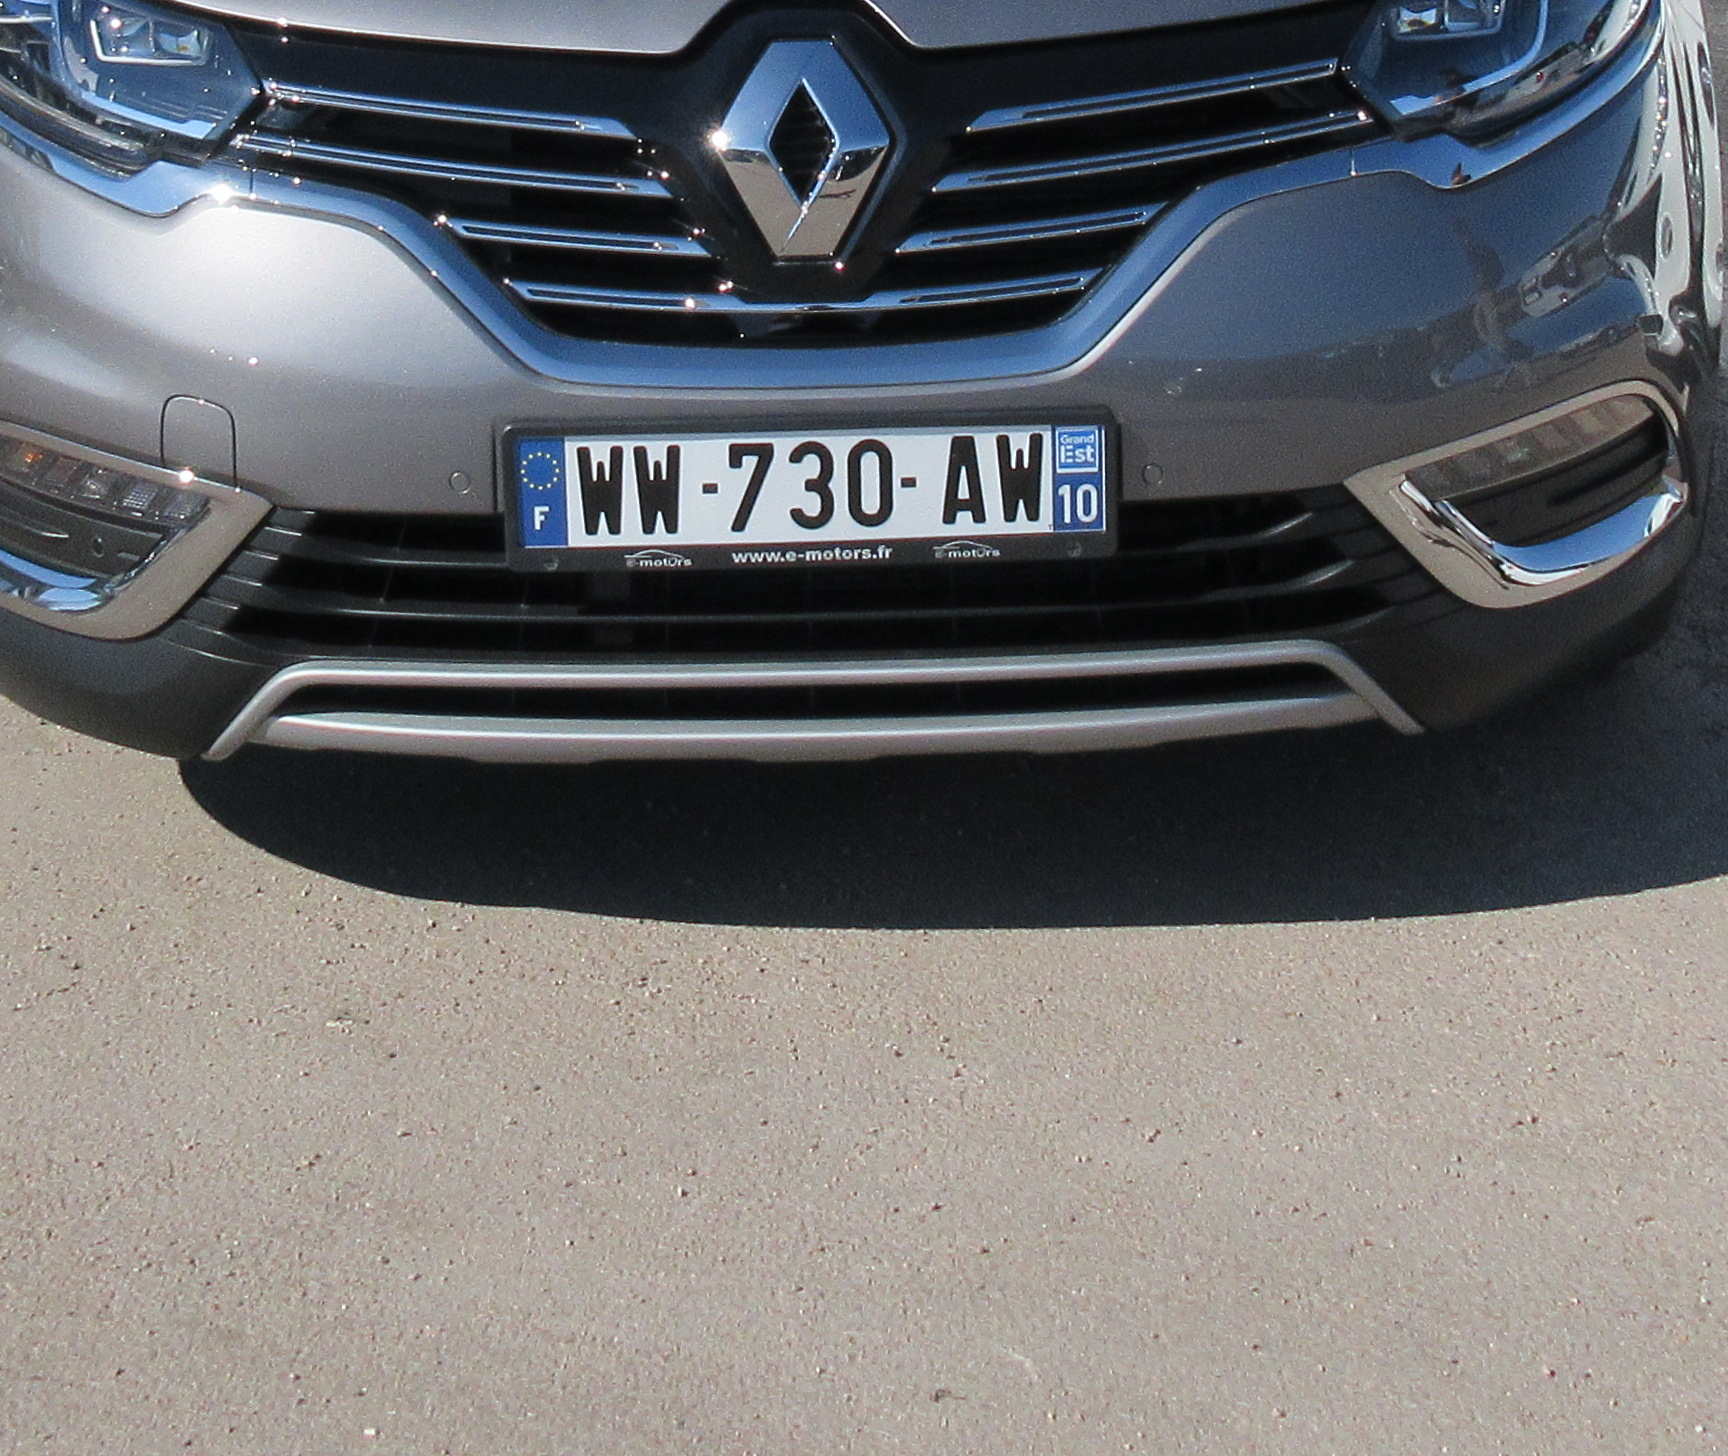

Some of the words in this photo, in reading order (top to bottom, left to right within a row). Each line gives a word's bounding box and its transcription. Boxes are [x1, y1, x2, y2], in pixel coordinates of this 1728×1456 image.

[1059, 433, 1095, 444] Grand
[1060, 444, 1095, 463] Est
[575, 433, 1045, 536] WW-730-AW
[1058, 483, 1098, 524] 10
[533, 506, 548, 531] F
[731, 545, 894, 564] www.e-motors.fr
